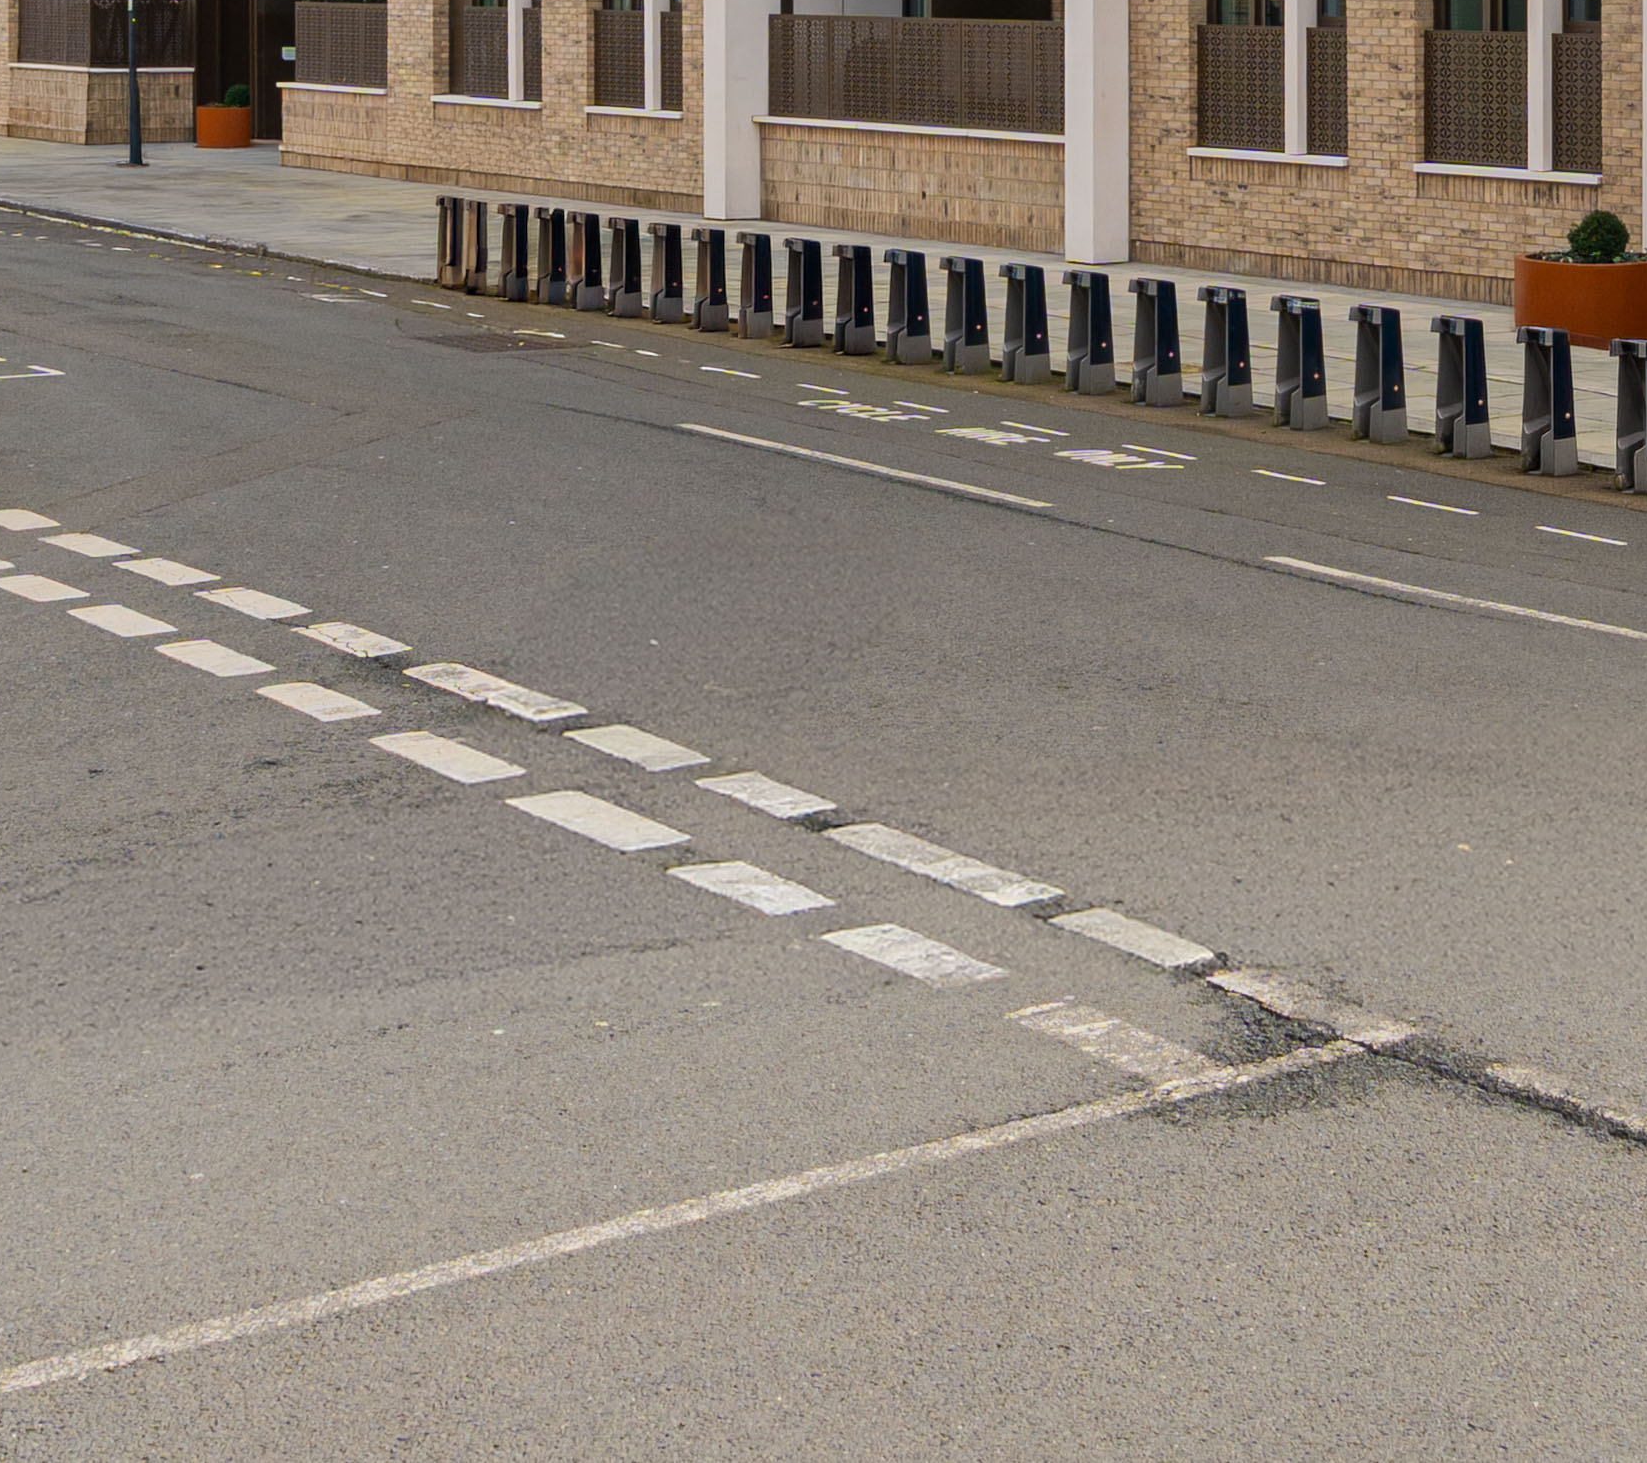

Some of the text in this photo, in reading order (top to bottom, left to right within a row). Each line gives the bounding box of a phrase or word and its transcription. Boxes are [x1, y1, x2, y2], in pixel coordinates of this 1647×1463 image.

[796, 399, 1185, 470] CYCLE HIRE ONLY
